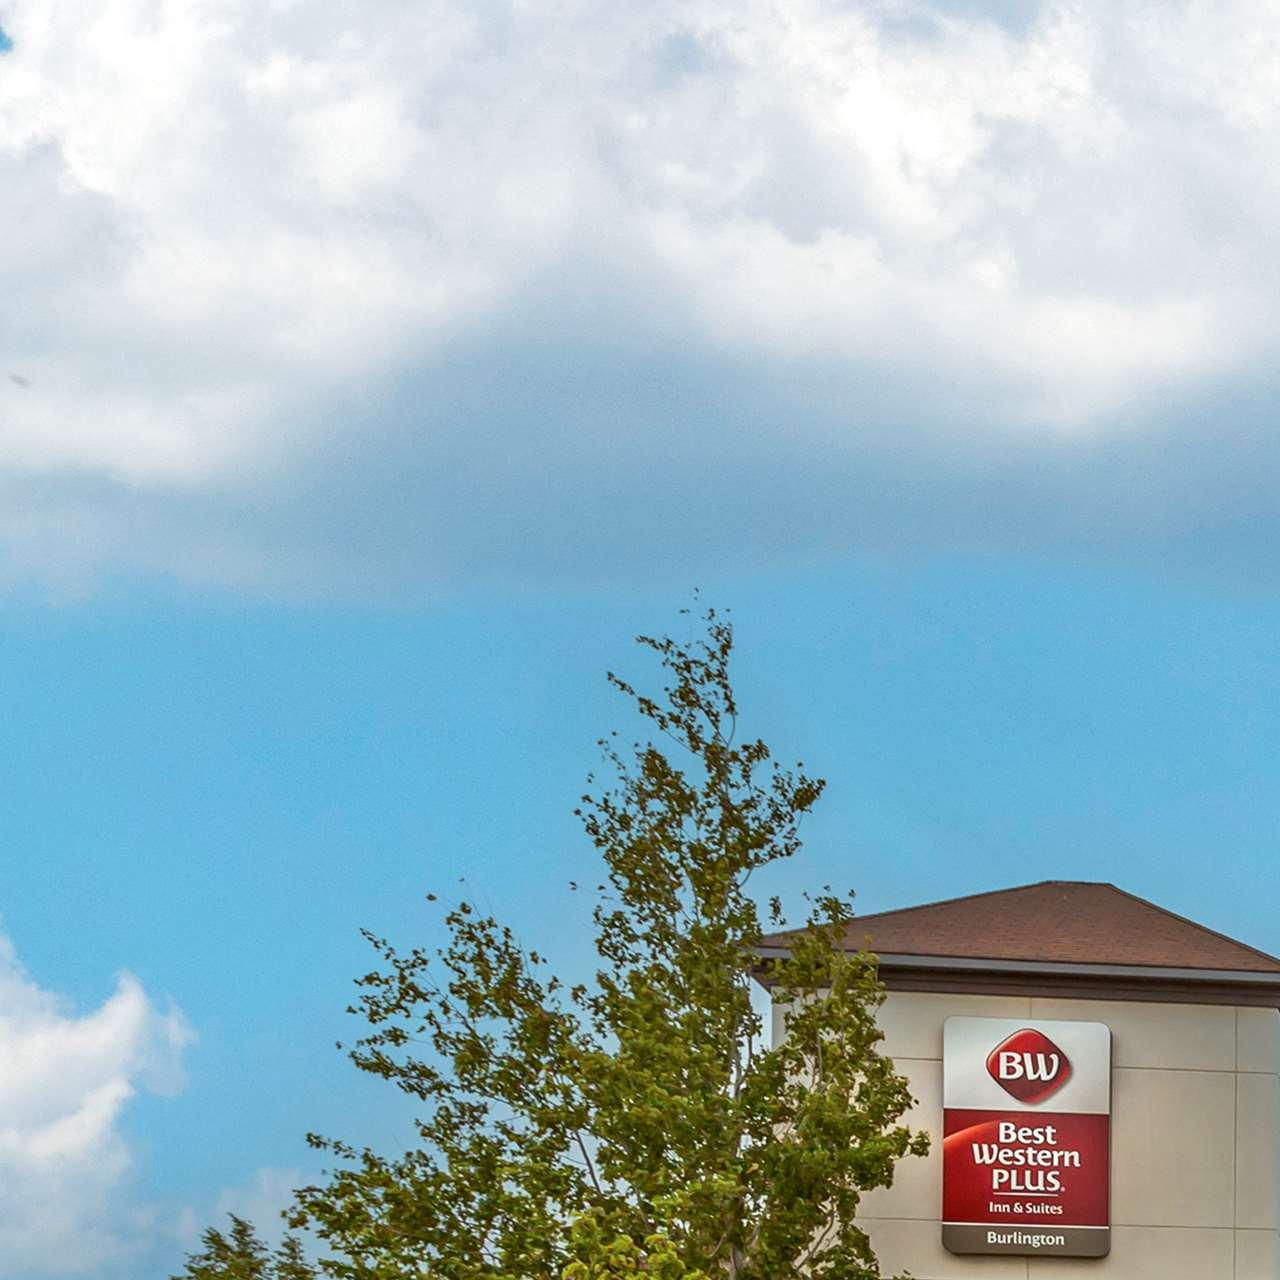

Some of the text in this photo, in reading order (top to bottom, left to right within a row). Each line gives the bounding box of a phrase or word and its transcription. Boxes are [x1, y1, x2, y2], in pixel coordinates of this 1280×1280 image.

[999, 1051, 1060, 1082] BW
[999, 1122, 1057, 1145] Best
[972, 1143, 1081, 1167] Western
[989, 1201, 1064, 1215] Inn & Suites
[987, 1231, 1065, 1248] Burlington
